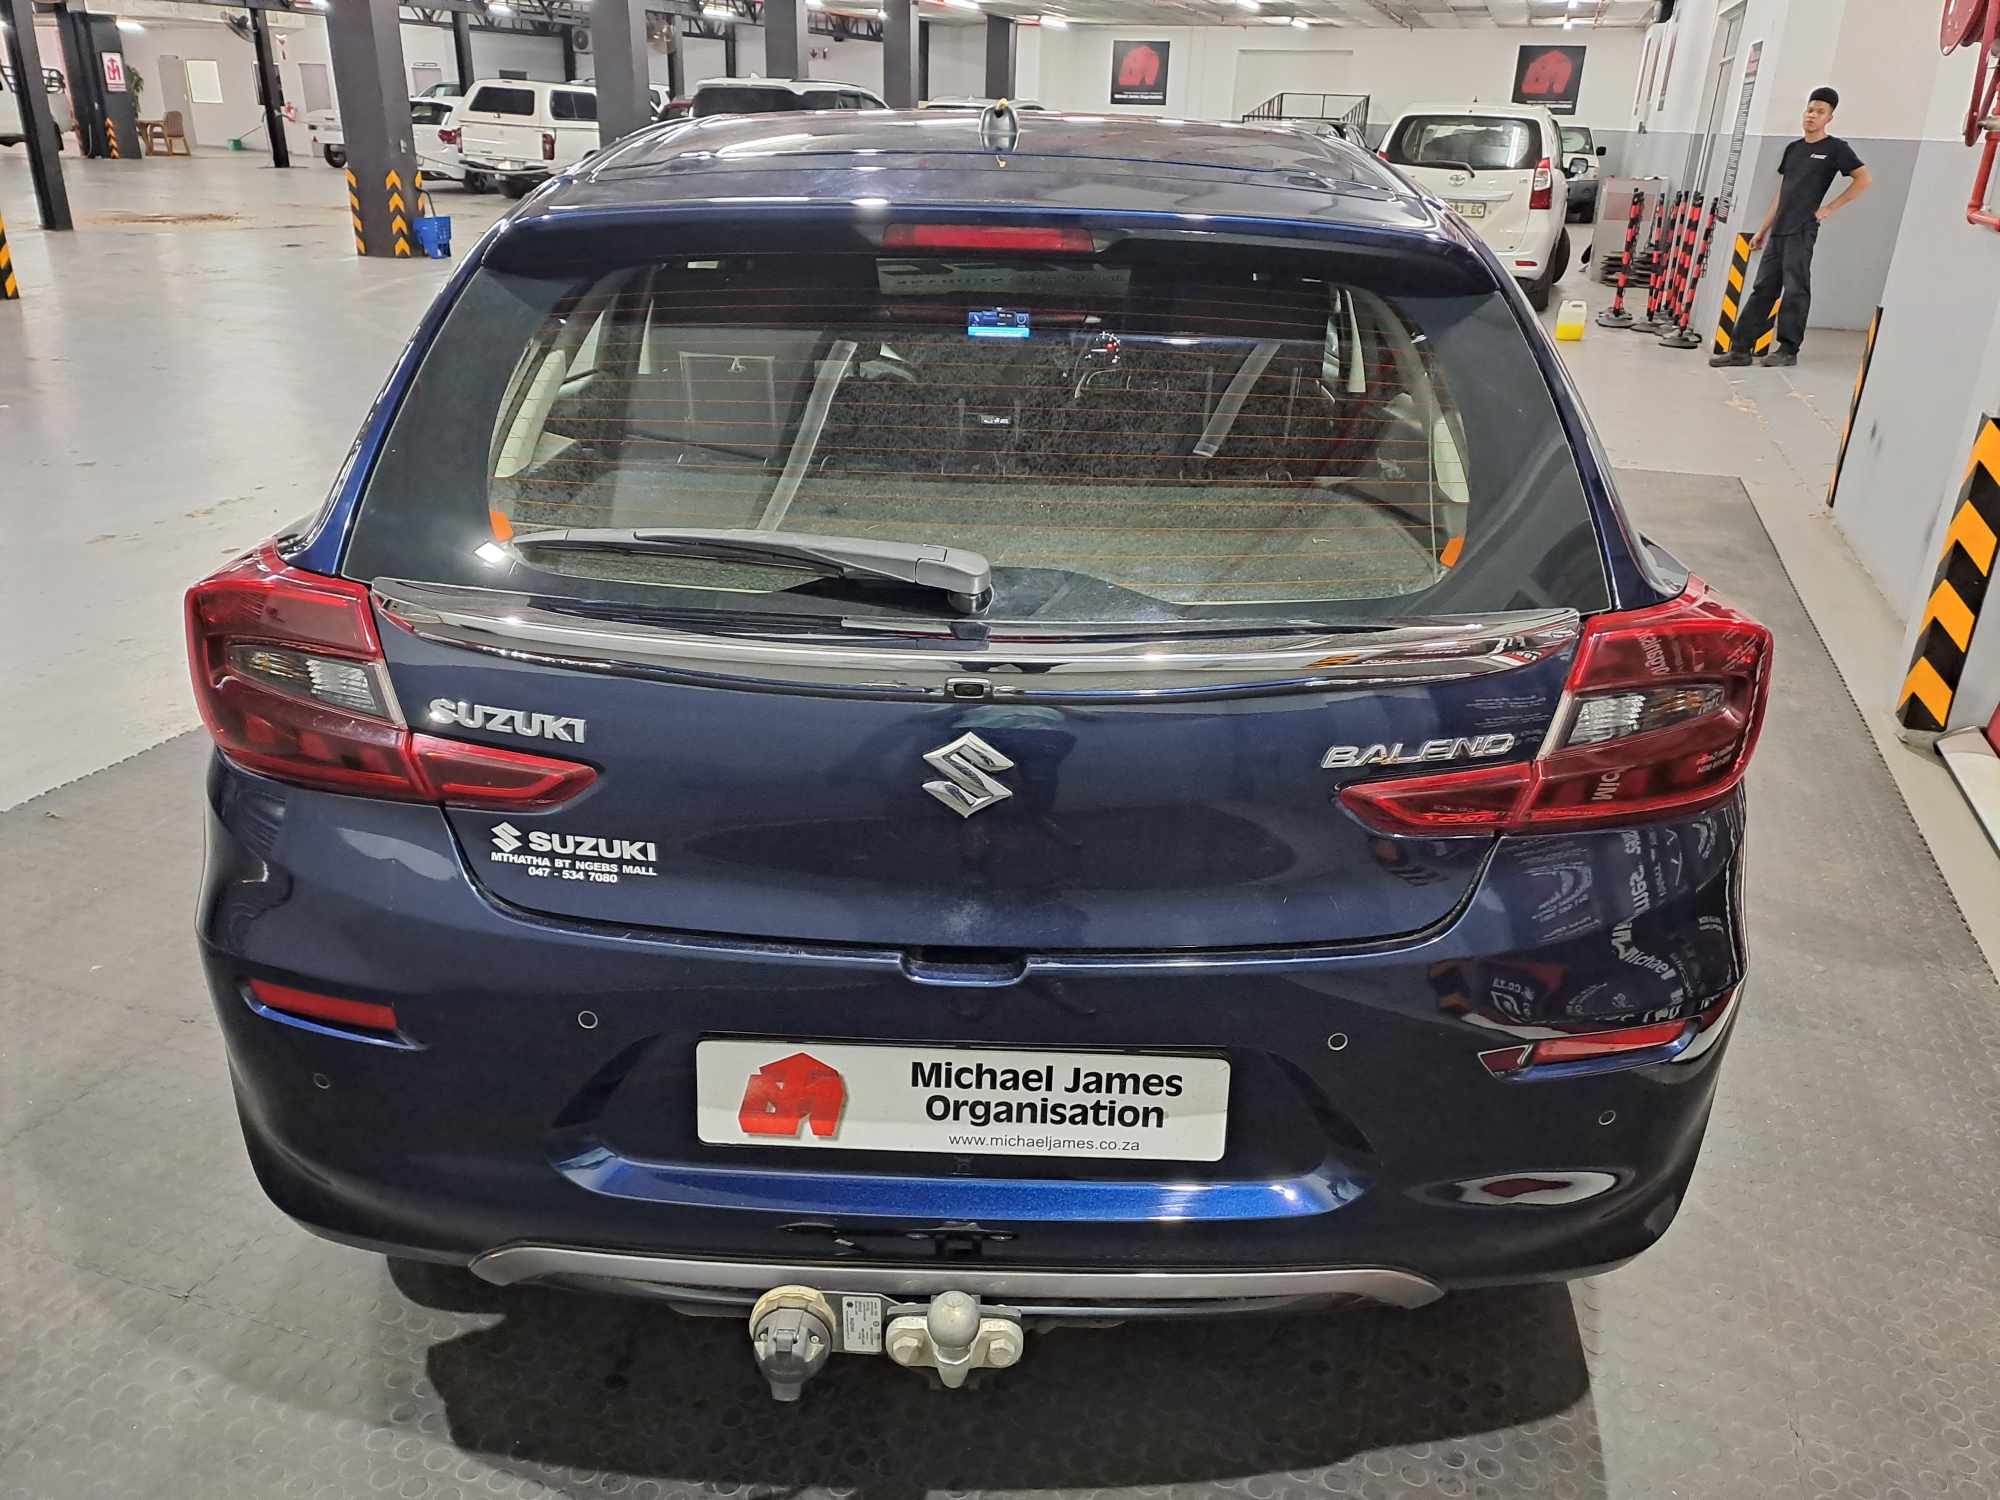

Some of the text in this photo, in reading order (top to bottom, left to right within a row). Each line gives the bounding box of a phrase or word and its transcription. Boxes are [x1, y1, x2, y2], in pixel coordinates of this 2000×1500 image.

[428, 698, 586, 744] SUZUKI
[1321, 733, 1515, 769] BALENO
[528, 831, 656, 862] SUZUKI
[491, 852, 658, 876] MTHATHA BT NGEBS MALL
[528, 866, 549, 877] 047
[562, 870, 584, 881] 534
[589, 872, 618, 883] 7080
[911, 1061, 1184, 1097] Michael James
[926, 1094, 1165, 1128] Organisation
[948, 1133, 1140, 1152] www.michaeljames.co.za
